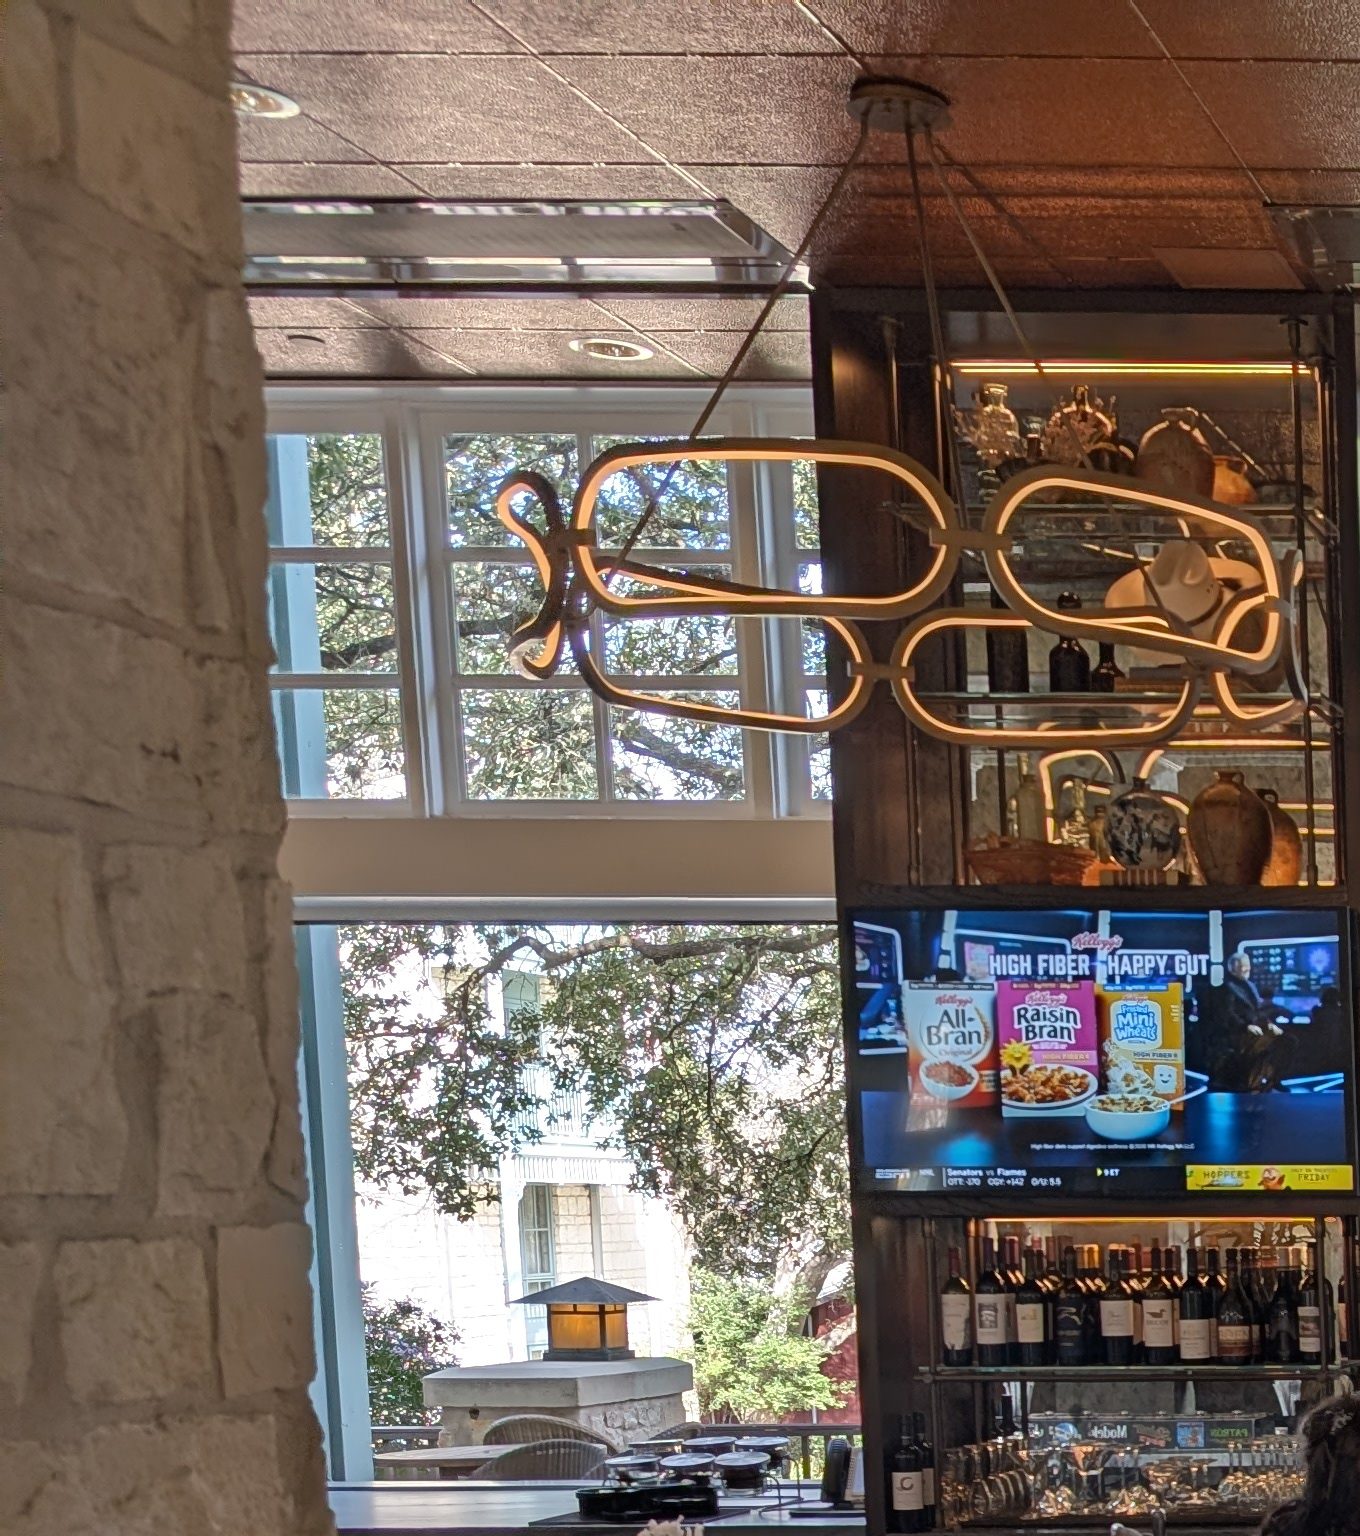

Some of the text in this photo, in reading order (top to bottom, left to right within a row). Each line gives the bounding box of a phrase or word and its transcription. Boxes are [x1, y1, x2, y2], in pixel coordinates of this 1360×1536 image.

[1072, 931, 1123, 951] Kellogg's
[989, 954, 1210, 976] HIGH FIBER HAPPY GUT
[940, 1009, 975, 1029] All-
[1015, 1007, 1079, 1026] Raisin
[1117, 1012, 1155, 1027] Mini
[927, 1026, 982, 1046] Bran
[1025, 1024, 1074, 1042] Bran
[1115, 1025, 1157, 1041] Wheats
[947, 1168, 983, 1177] Senators
[997, 1168, 1027, 1177] Flames
[1203, 1170, 1251, 1179] HOPPERS
[1298, 1173, 1330, 1182] FRIDAY
